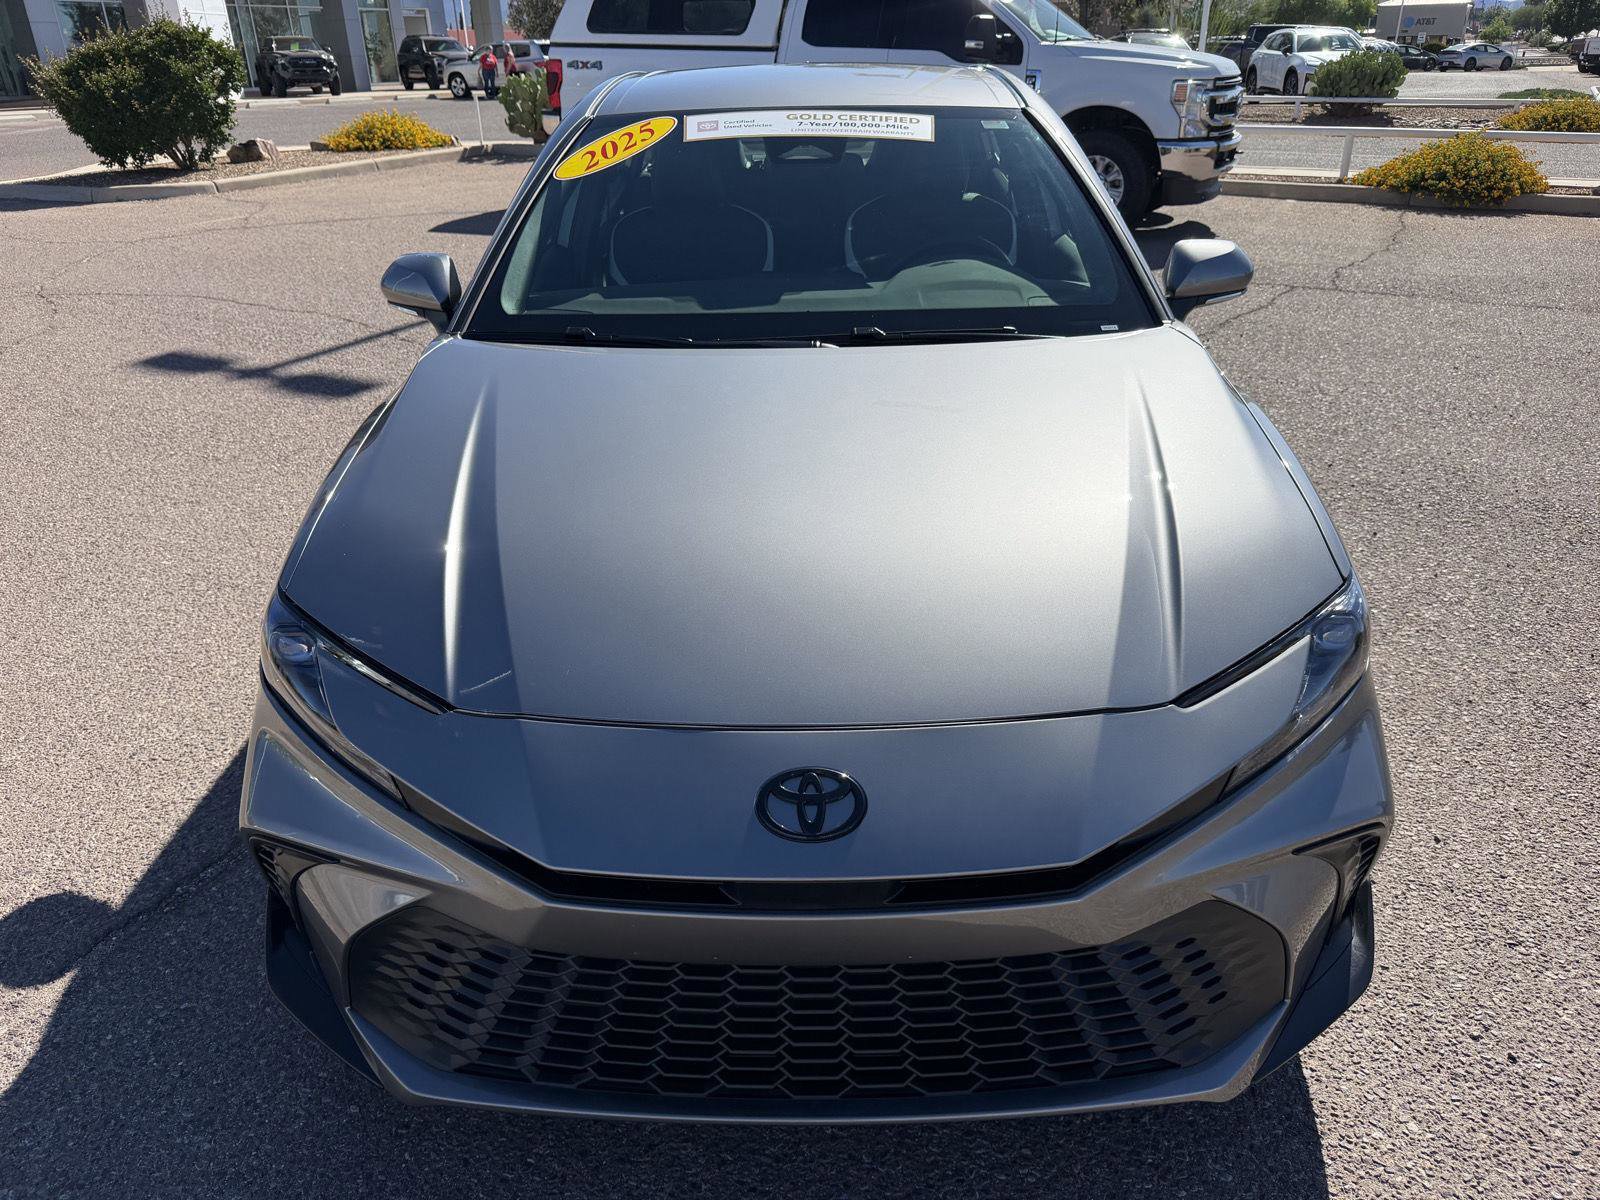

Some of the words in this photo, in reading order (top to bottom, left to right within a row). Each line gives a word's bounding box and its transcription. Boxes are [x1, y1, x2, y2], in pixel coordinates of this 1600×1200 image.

[1415, 17, 1437, 26] AT&T
[837, 113, 920, 124] CERTIFIED
[797, 121, 910, 129] 7-Year/100,000-Mile
[581, 121, 655, 172] 2025
